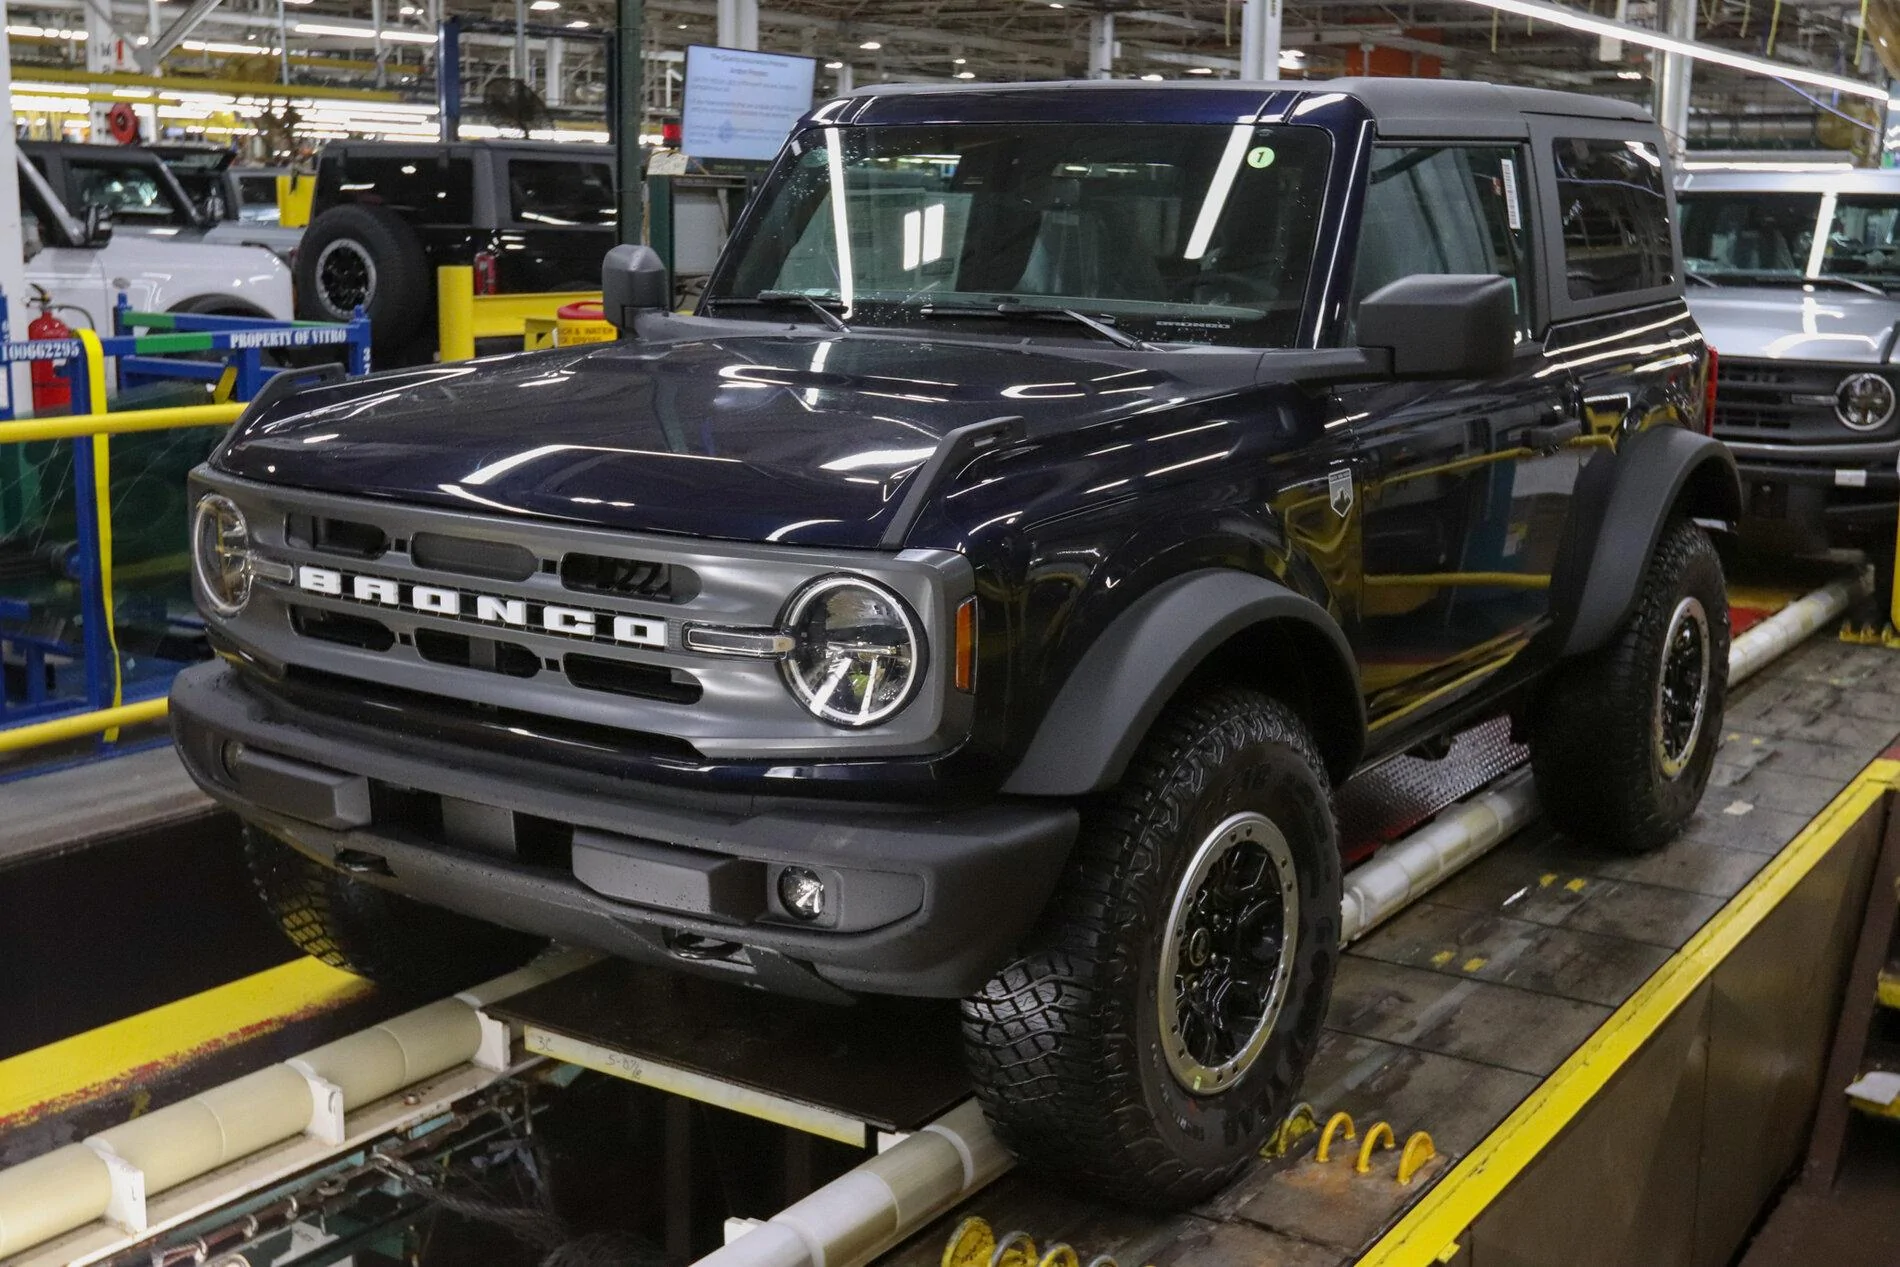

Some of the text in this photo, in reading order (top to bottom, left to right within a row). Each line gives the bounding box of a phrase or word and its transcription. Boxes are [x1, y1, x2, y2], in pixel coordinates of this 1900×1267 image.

[230, 329, 347, 349] PROPERTY OF VITRO
[300, 566, 667, 647] BRONCO
